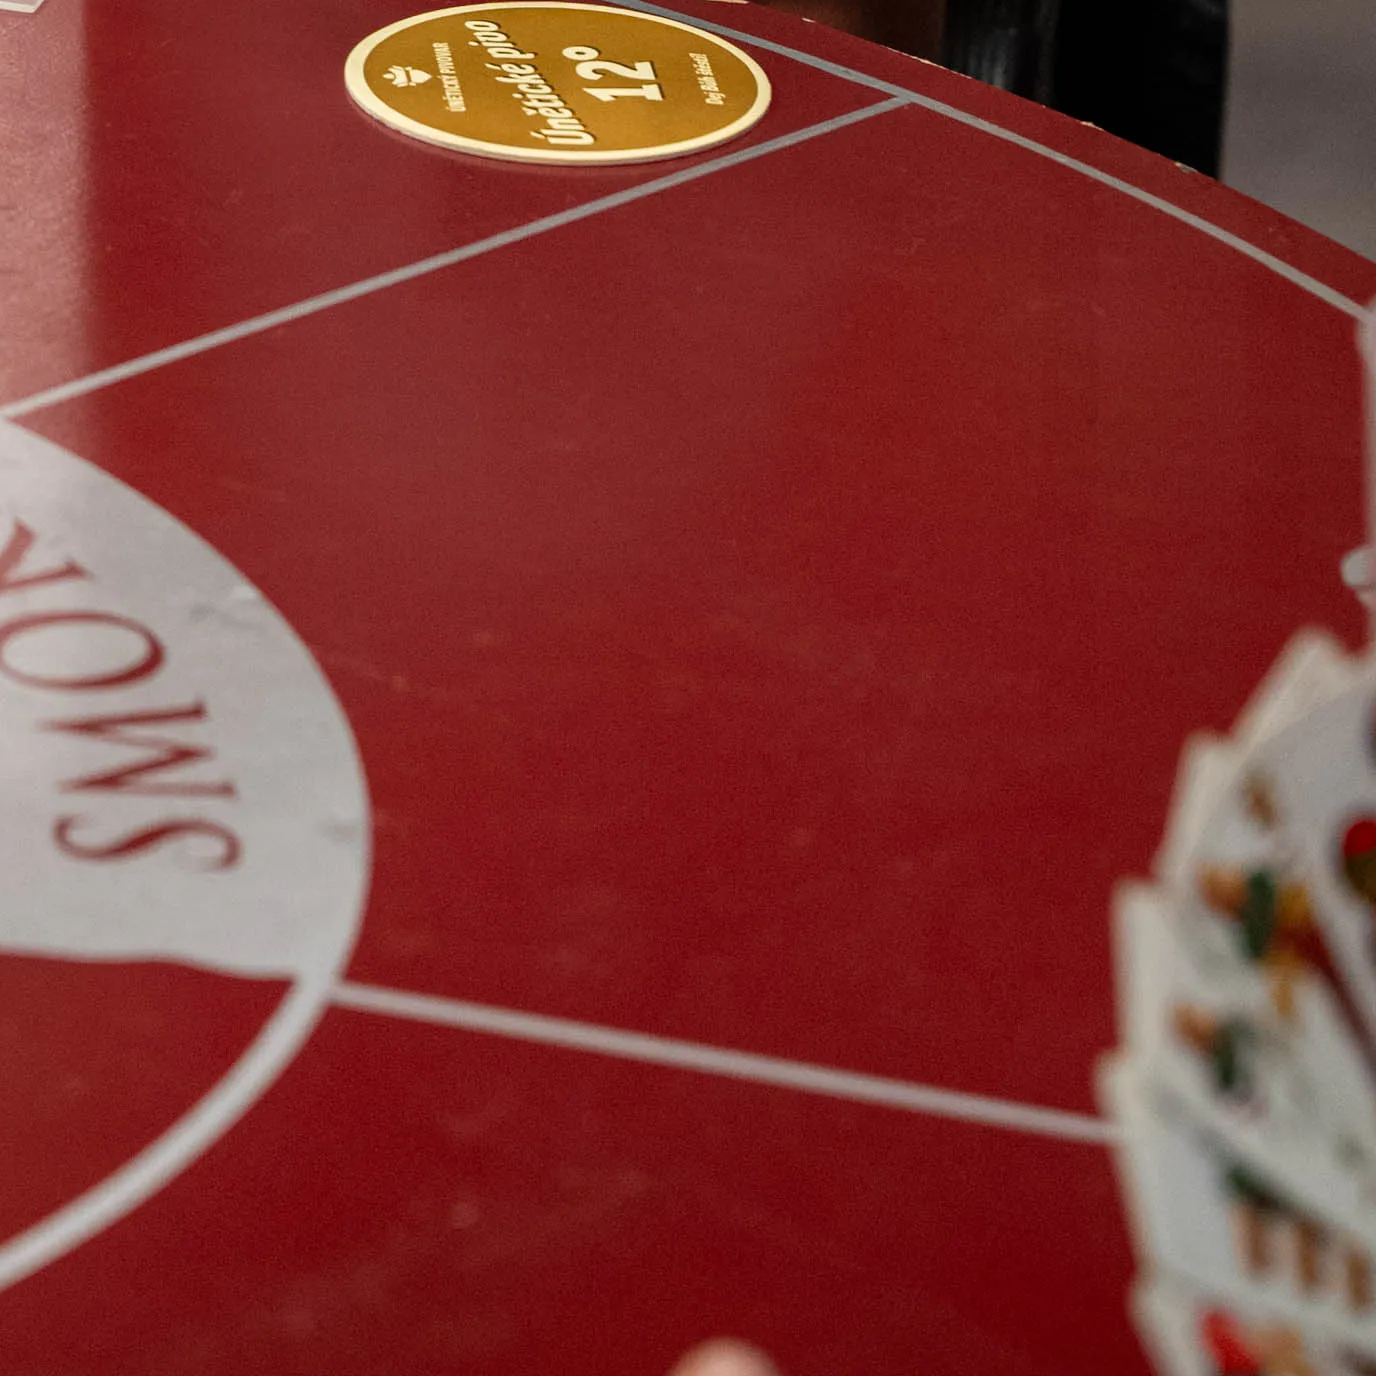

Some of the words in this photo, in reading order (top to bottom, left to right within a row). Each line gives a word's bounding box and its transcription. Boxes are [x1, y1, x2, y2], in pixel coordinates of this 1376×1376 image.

[432, 42, 456, 74] PIVOVAR
[464, 20, 536, 60] pivo
[485, 62, 595, 145] Únětické
